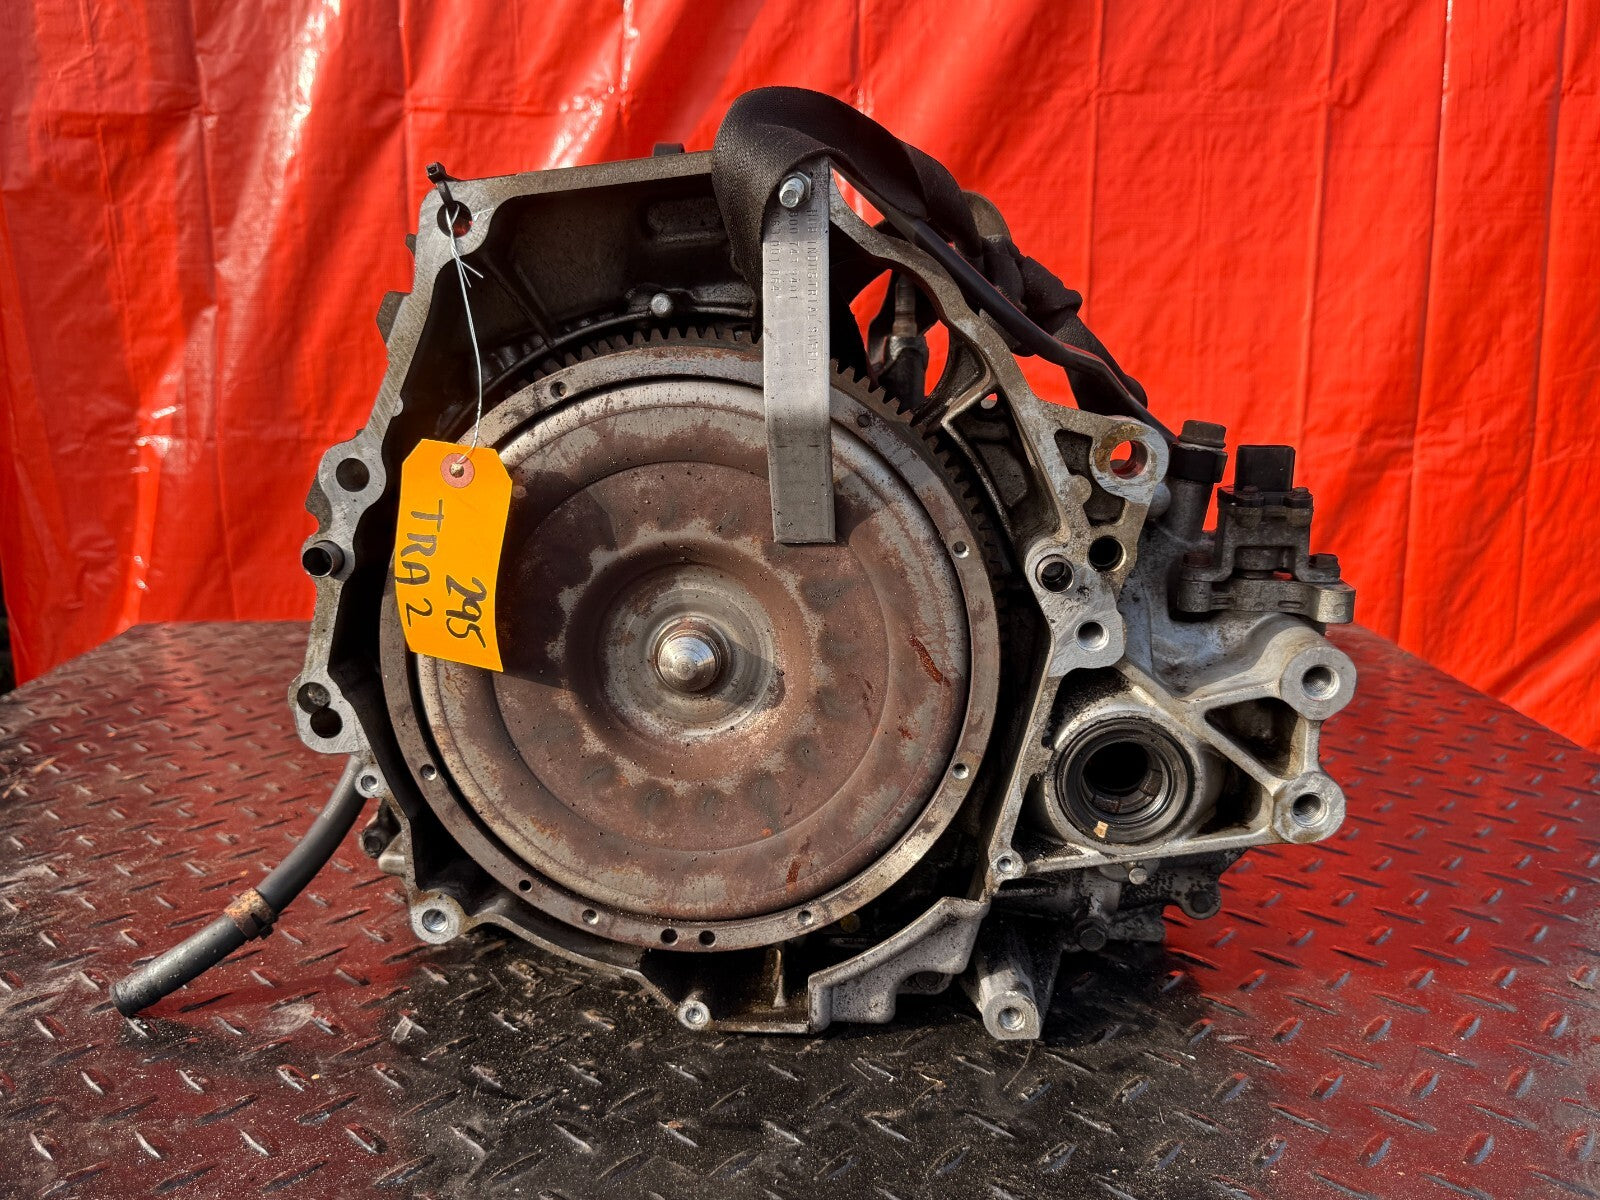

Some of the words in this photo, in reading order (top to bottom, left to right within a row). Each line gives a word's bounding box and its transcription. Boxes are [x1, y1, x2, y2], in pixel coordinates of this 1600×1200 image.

[788, 211, 800, 235] 800
[806, 240, 819, 321] INDUSTRIAL
[806, 326, 819, 374] SUPPLY
[446, 574, 488, 648] 295
